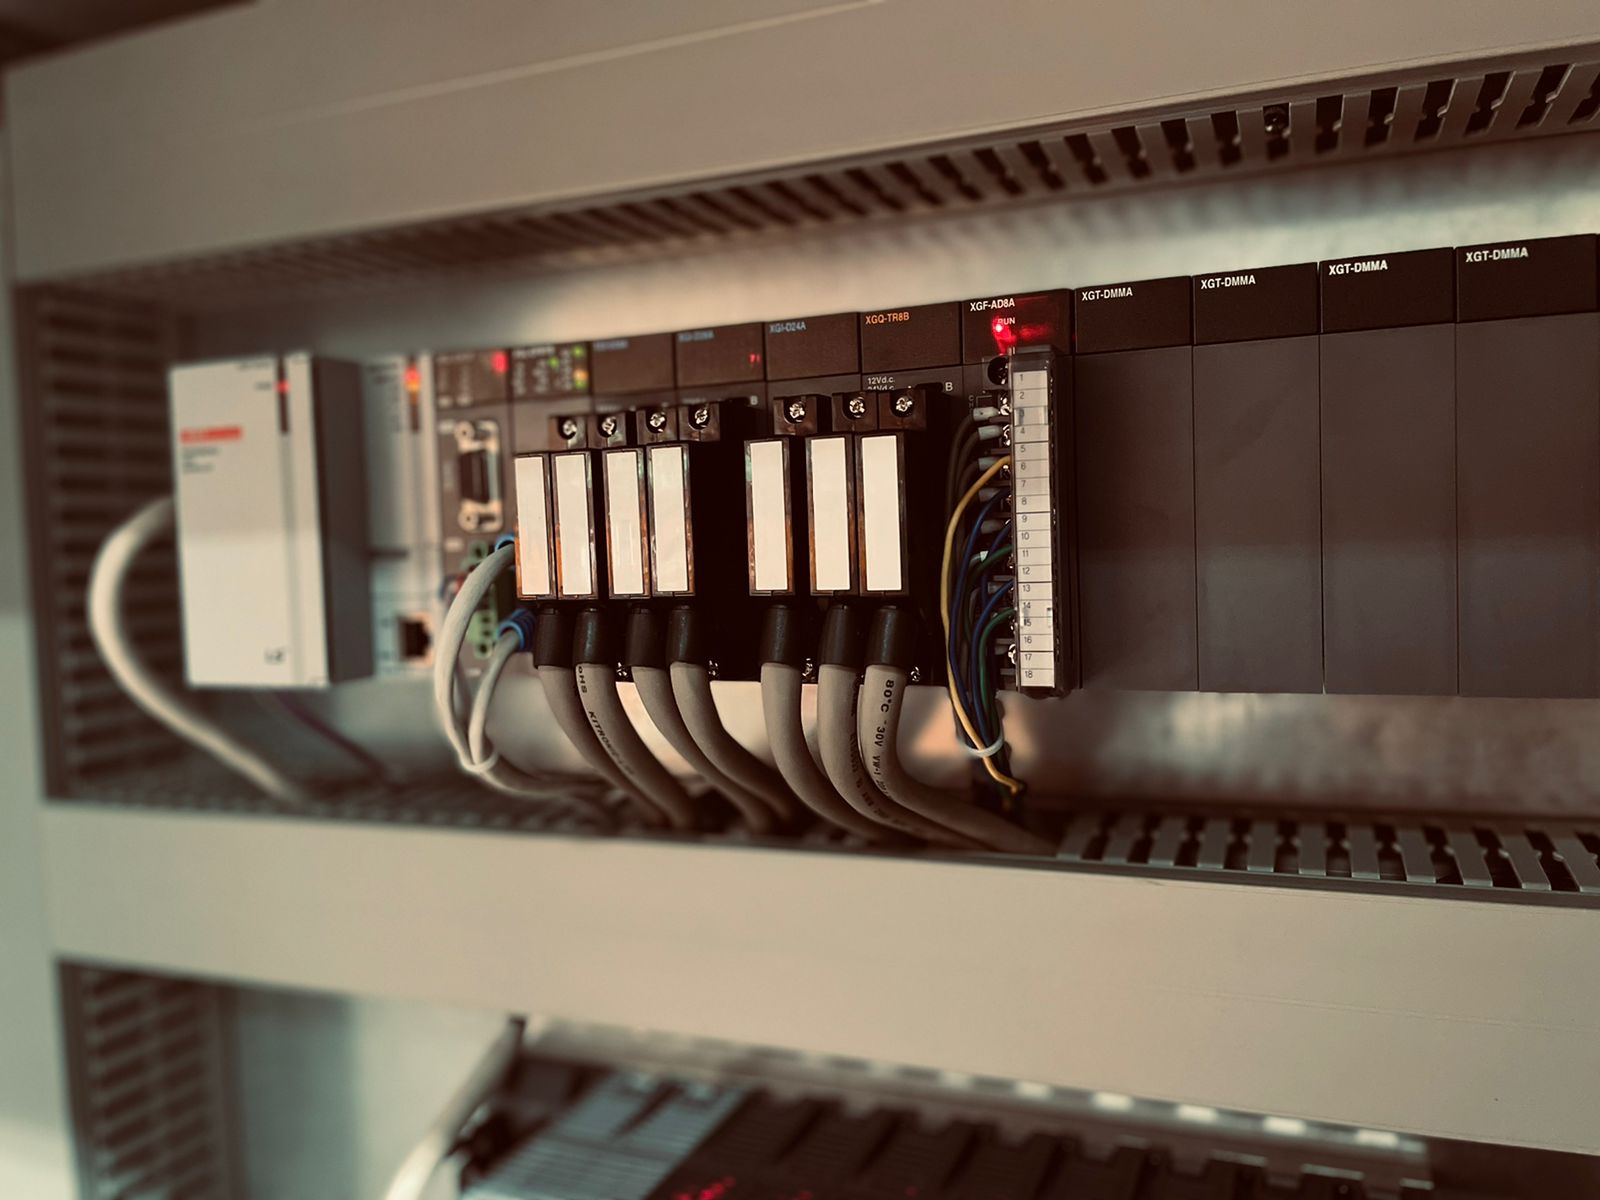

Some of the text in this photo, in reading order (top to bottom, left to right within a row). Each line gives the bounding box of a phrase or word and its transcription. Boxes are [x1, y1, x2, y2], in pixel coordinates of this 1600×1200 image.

[1465, 247, 1529, 263] XGT-DMMA
[1328, 260, 1388, 276] XGT-DMMA
[1200, 274, 1256, 290] XGT-DMMA
[1081, 286, 1134, 302] XGT-DMMA
[969, 298, 1016, 312] XGF-AD8A
[864, 311, 910, 325] XGQ-TR8B
[1019, 373, 1024, 382] 1
[945, 381, 954, 392] B
[1019, 391, 1025, 400] 2
[1020, 426, 1026, 435] 4
[1020, 444, 1026, 453] 5
[1020, 462, 1027, 470] 6
[1021, 479, 1027, 488] 7
[1021, 497, 1028, 506] 8
[1021, 514, 1028, 523] 9
[1021, 532, 1030, 541] 10
[1022, 549, 1030, 558] 11
[1022, 567, 1030, 576] 12
[1022, 584, 1031, 593] 13
[1023, 601, 1031, 610] 14
[1024, 635, 1032, 644] 16
[1024, 653, 1033, 662] 17
[1024, 670, 1033, 679] 18
[880, 679, 895, 713] 80°C
[874, 726, 886, 747] 30V
